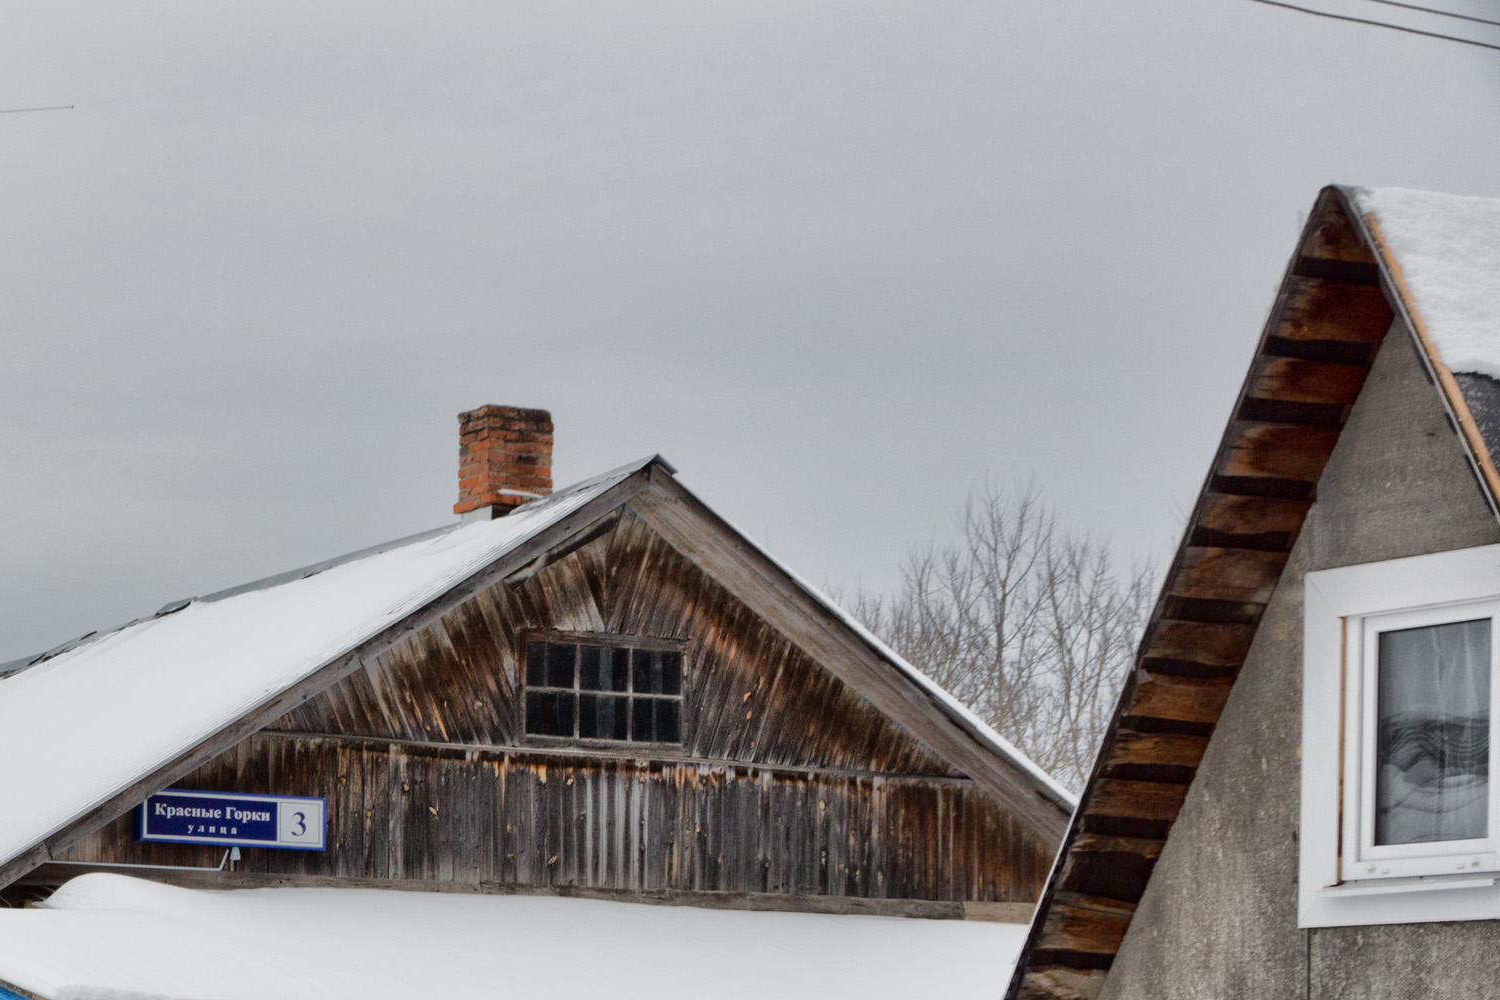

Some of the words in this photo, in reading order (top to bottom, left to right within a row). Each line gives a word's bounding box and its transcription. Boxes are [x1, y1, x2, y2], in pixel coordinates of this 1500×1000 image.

[155, 803, 221, 819] Красные
[225, 807, 270, 823] Горки
[187, 824, 237, 835] улица
[291, 811, 307, 836] 3
